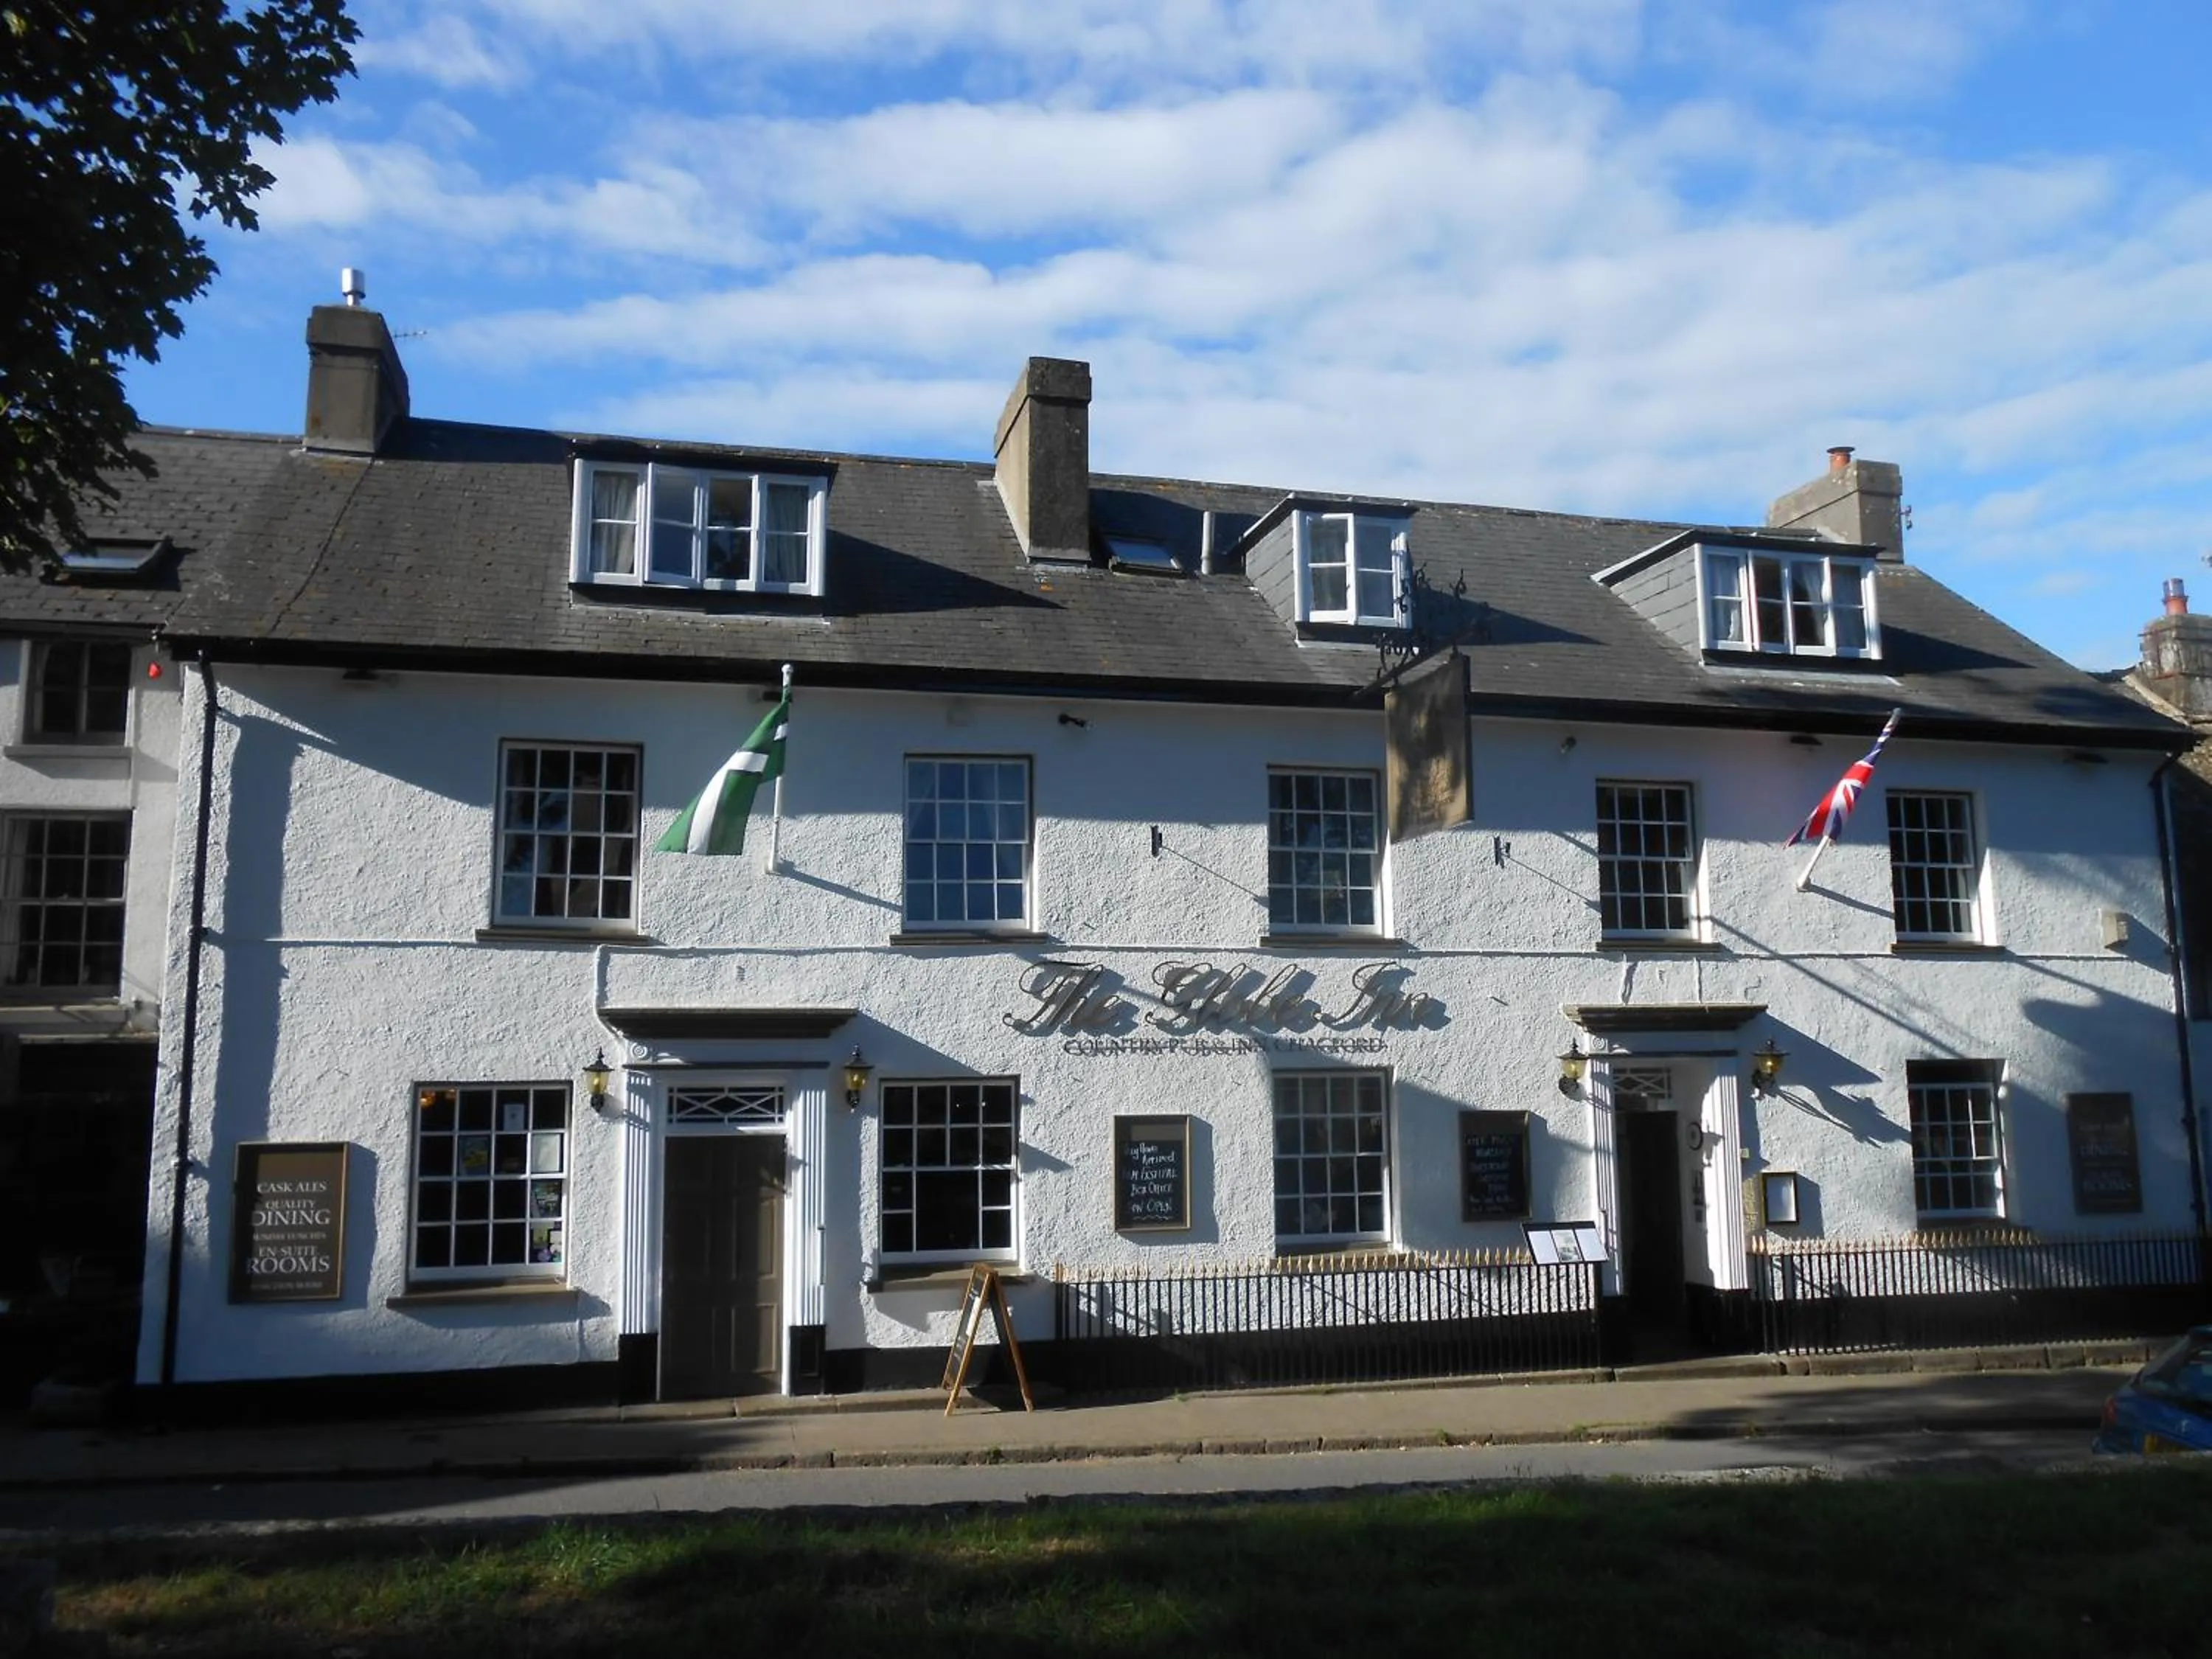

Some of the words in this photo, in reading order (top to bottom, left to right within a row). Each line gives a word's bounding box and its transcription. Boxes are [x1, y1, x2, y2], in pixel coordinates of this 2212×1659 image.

[1003, 961, 1121, 1029] The
[1145, 961, 1306, 1029] Globe
[1312, 961, 1430, 1029] Inn
[1064, 1038, 1163, 1056] COUNTRY
[1169, 1038, 1211, 1056] PUB
[1273, 1037, 1388, 1053] CHAGFORD
[257, 1181, 292, 1193] CASK
[296, 1180, 327, 1192] ALES
[265, 1200, 315, 1210] QUALITY
[251, 1209, 331, 1226] DINING
[247, 1256, 330, 1275] ROOMS
